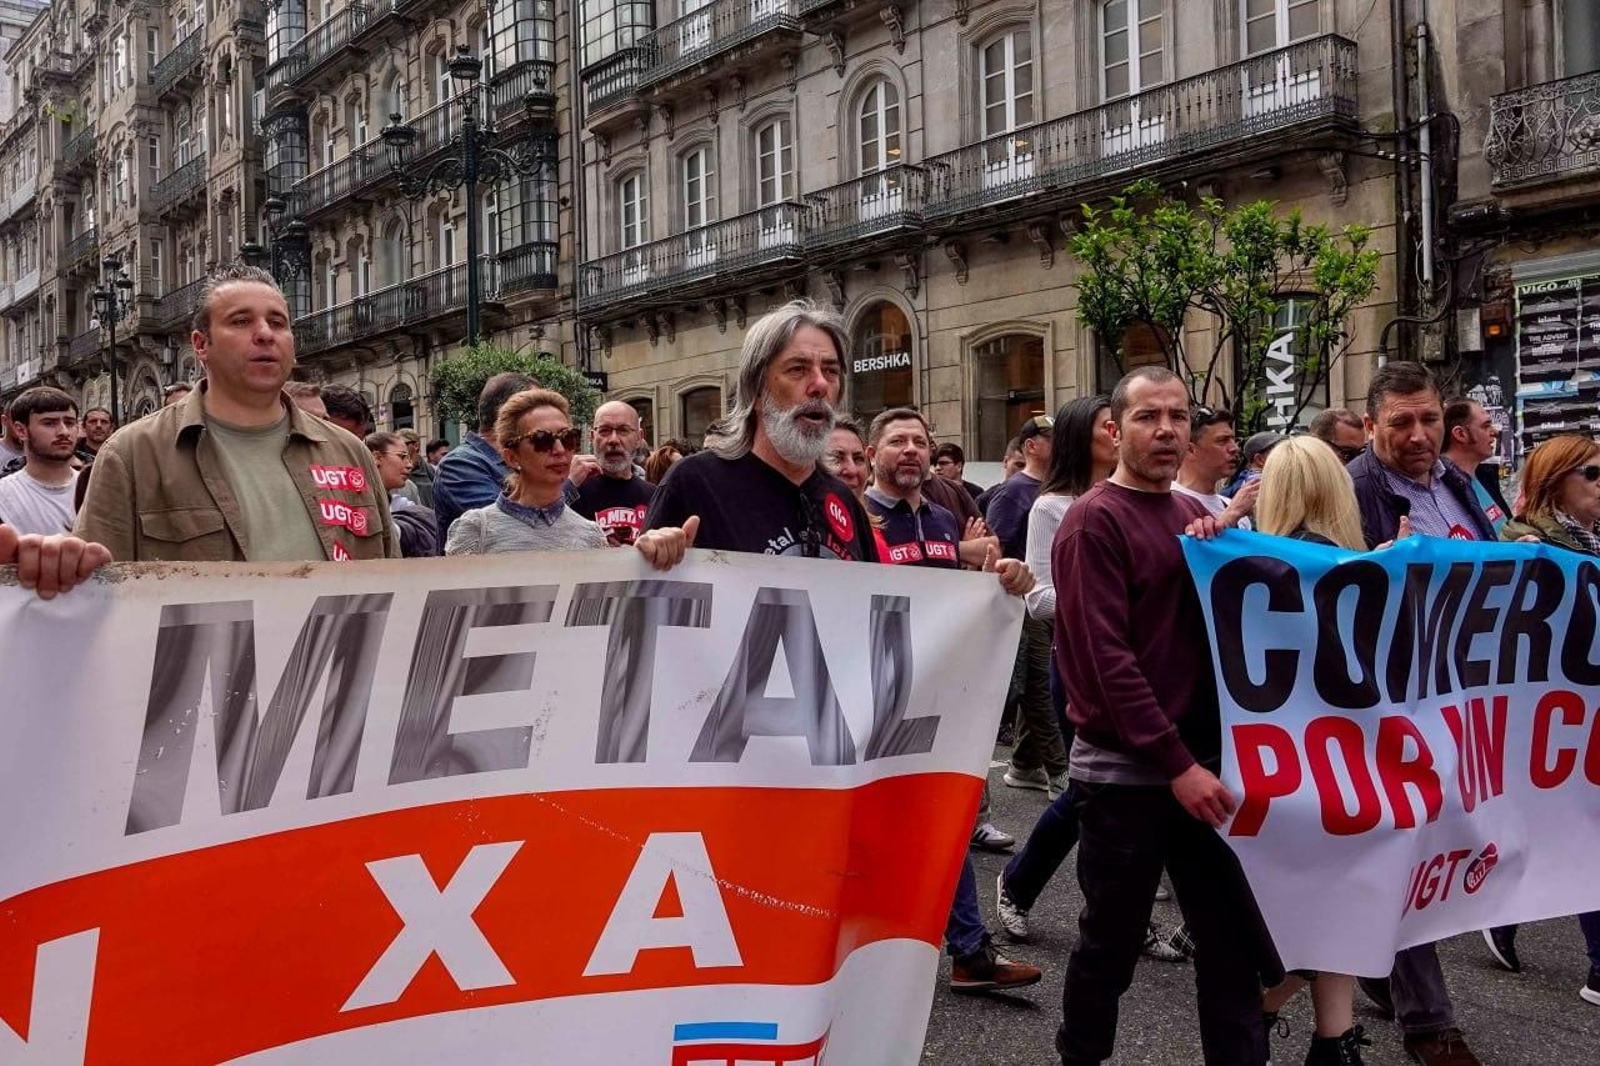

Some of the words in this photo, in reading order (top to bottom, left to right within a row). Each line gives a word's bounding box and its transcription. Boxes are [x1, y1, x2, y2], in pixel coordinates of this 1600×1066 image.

[1521, 282, 1558, 295] VIGO
[853, 352, 911, 373] BERSHKA
[1266, 331, 1295, 434] HKA
[311, 469, 347, 486] UGT
[321, 503, 353, 524] UGT
[764, 527, 795, 557] etal
[925, 543, 947, 556] UGT
[125, 579, 941, 837] METAL
[1228, 715, 1444, 837] POR
[1440, 696, 1509, 814] UN
